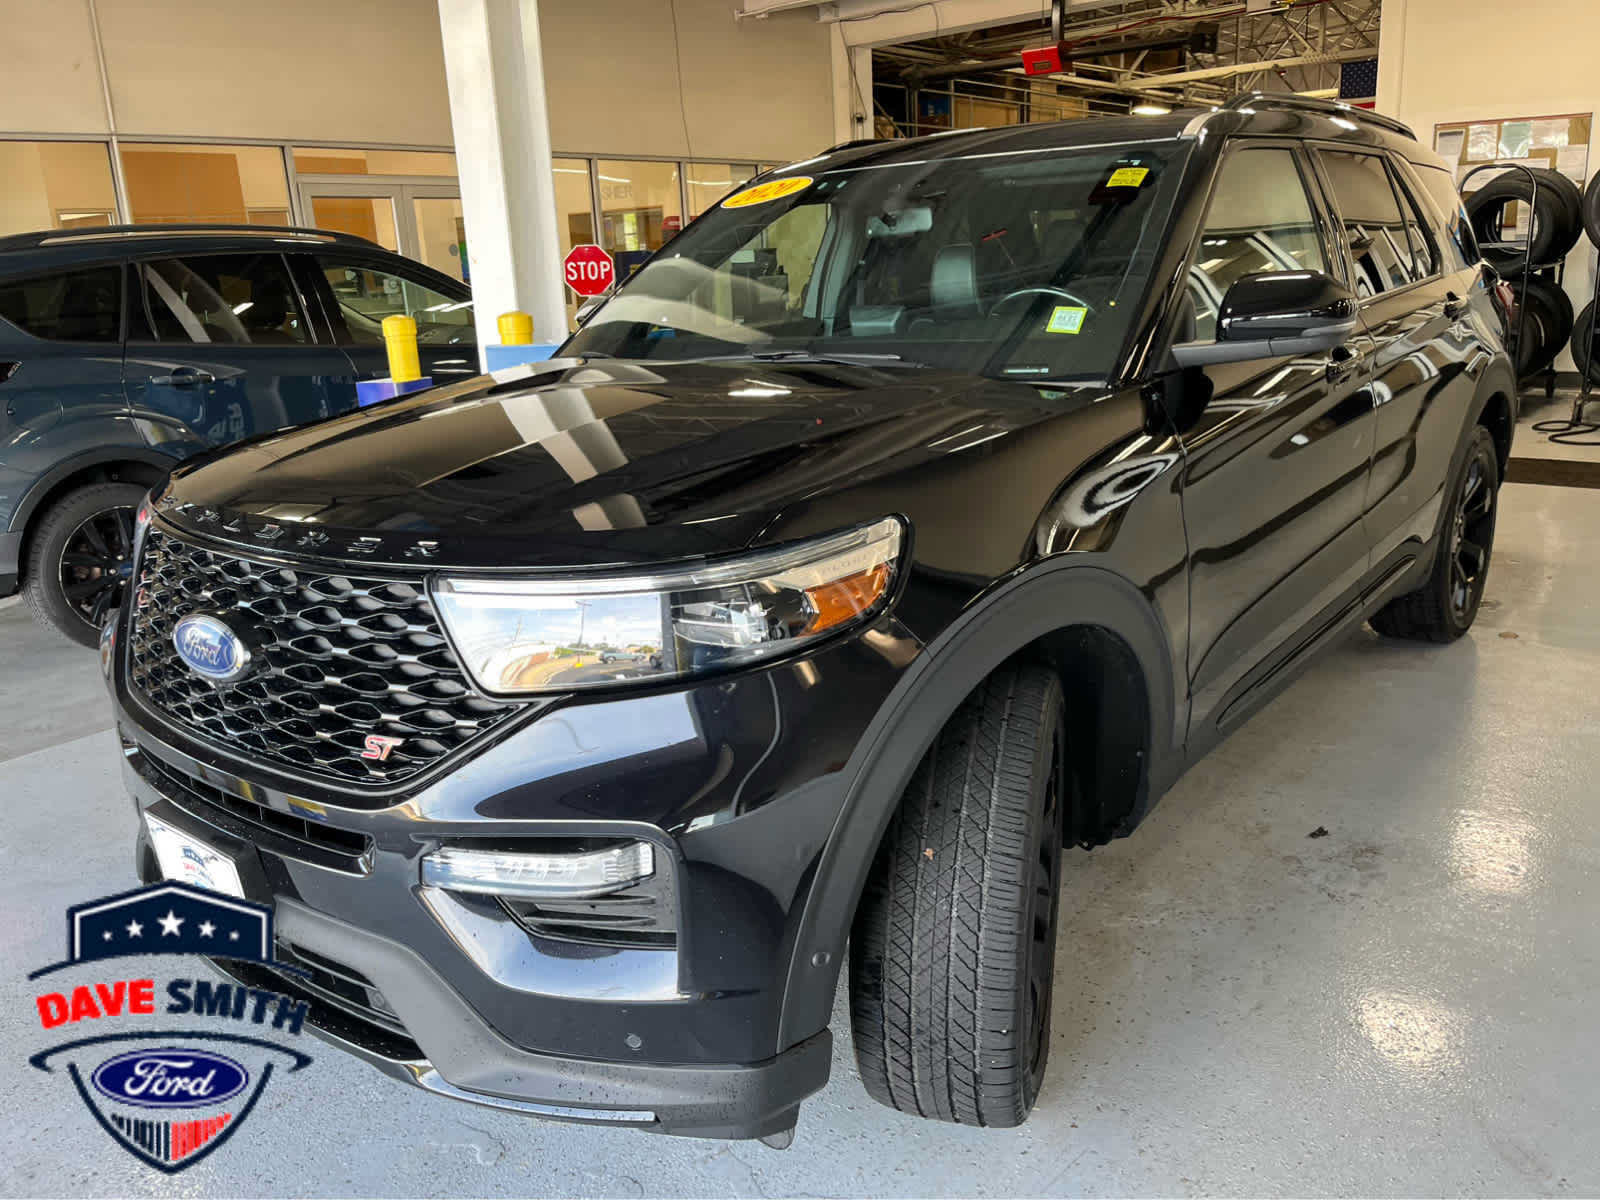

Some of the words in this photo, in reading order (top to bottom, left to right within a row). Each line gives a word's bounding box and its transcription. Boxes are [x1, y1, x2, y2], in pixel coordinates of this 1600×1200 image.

[566, 260, 611, 281] STOP
[183, 626, 222, 666] Ford
[360, 734, 406, 760] ST
